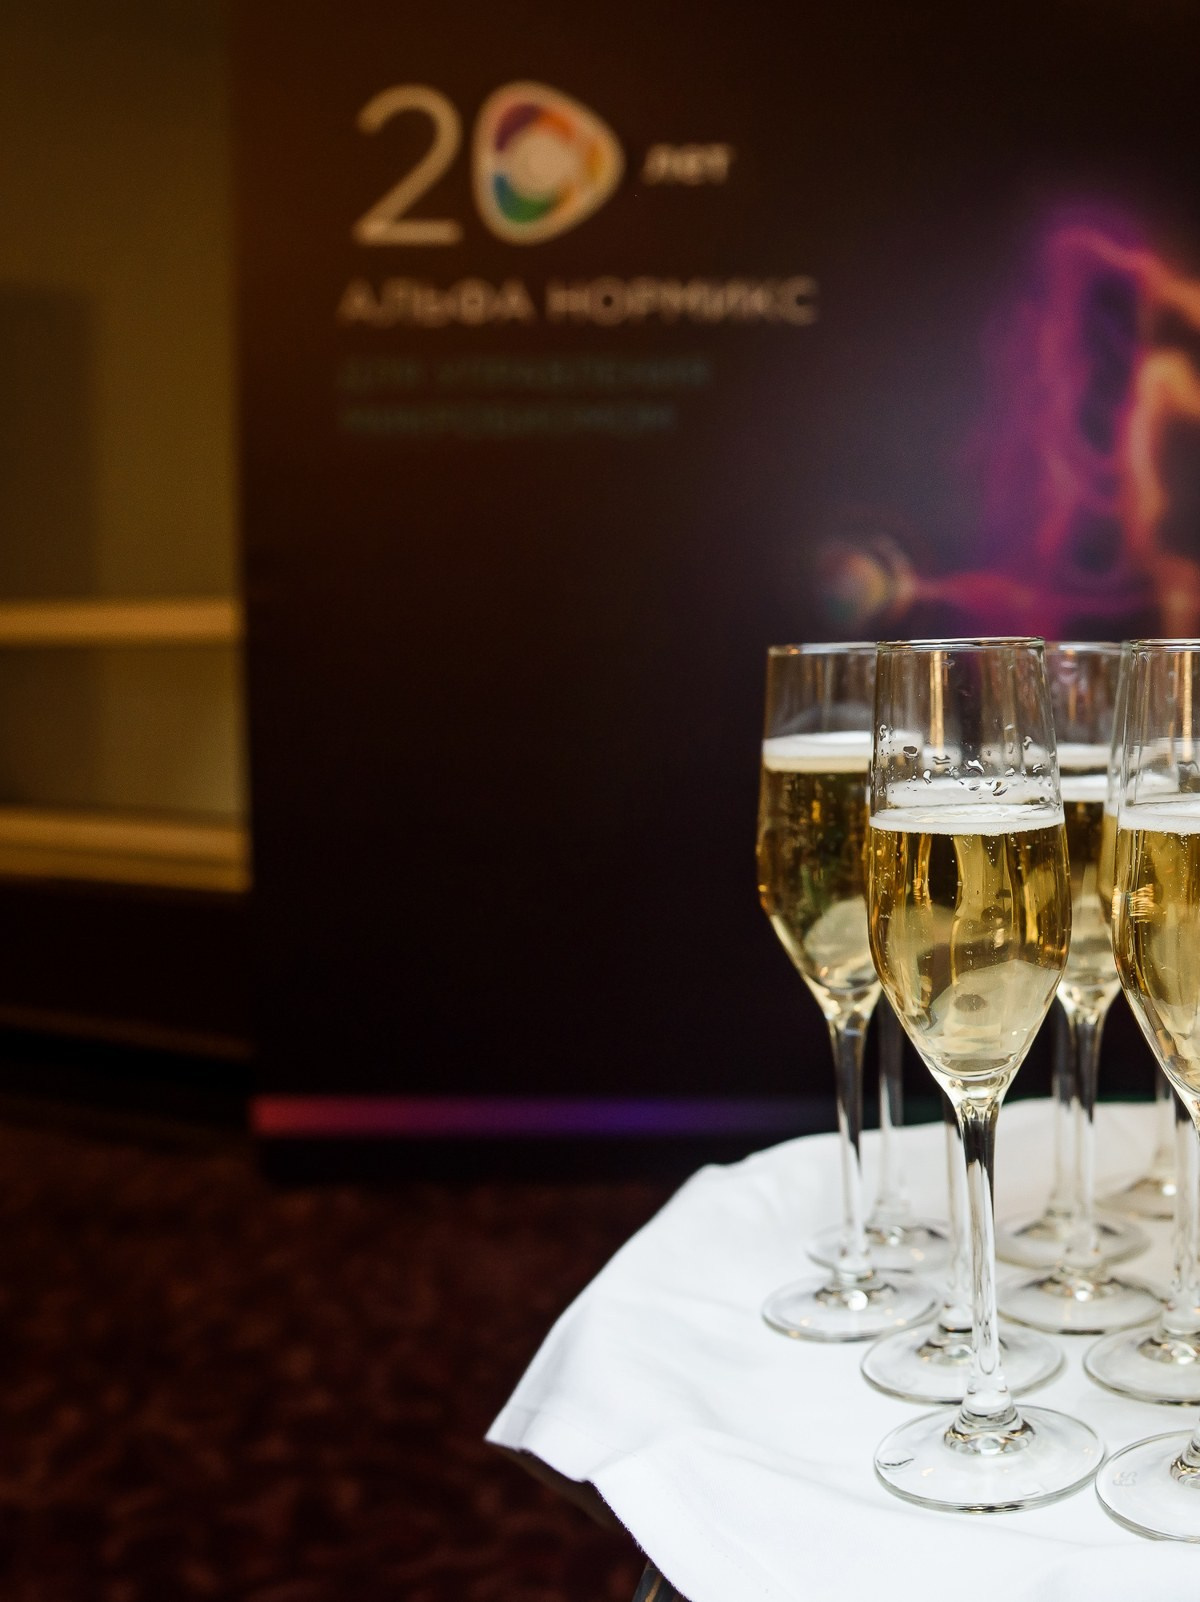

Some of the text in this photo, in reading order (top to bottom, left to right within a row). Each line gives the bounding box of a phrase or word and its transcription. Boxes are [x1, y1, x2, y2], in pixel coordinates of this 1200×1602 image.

[643, 143, 733, 185] лет
[338, 276, 819, 327] АЛЬФА НОРМИКС
